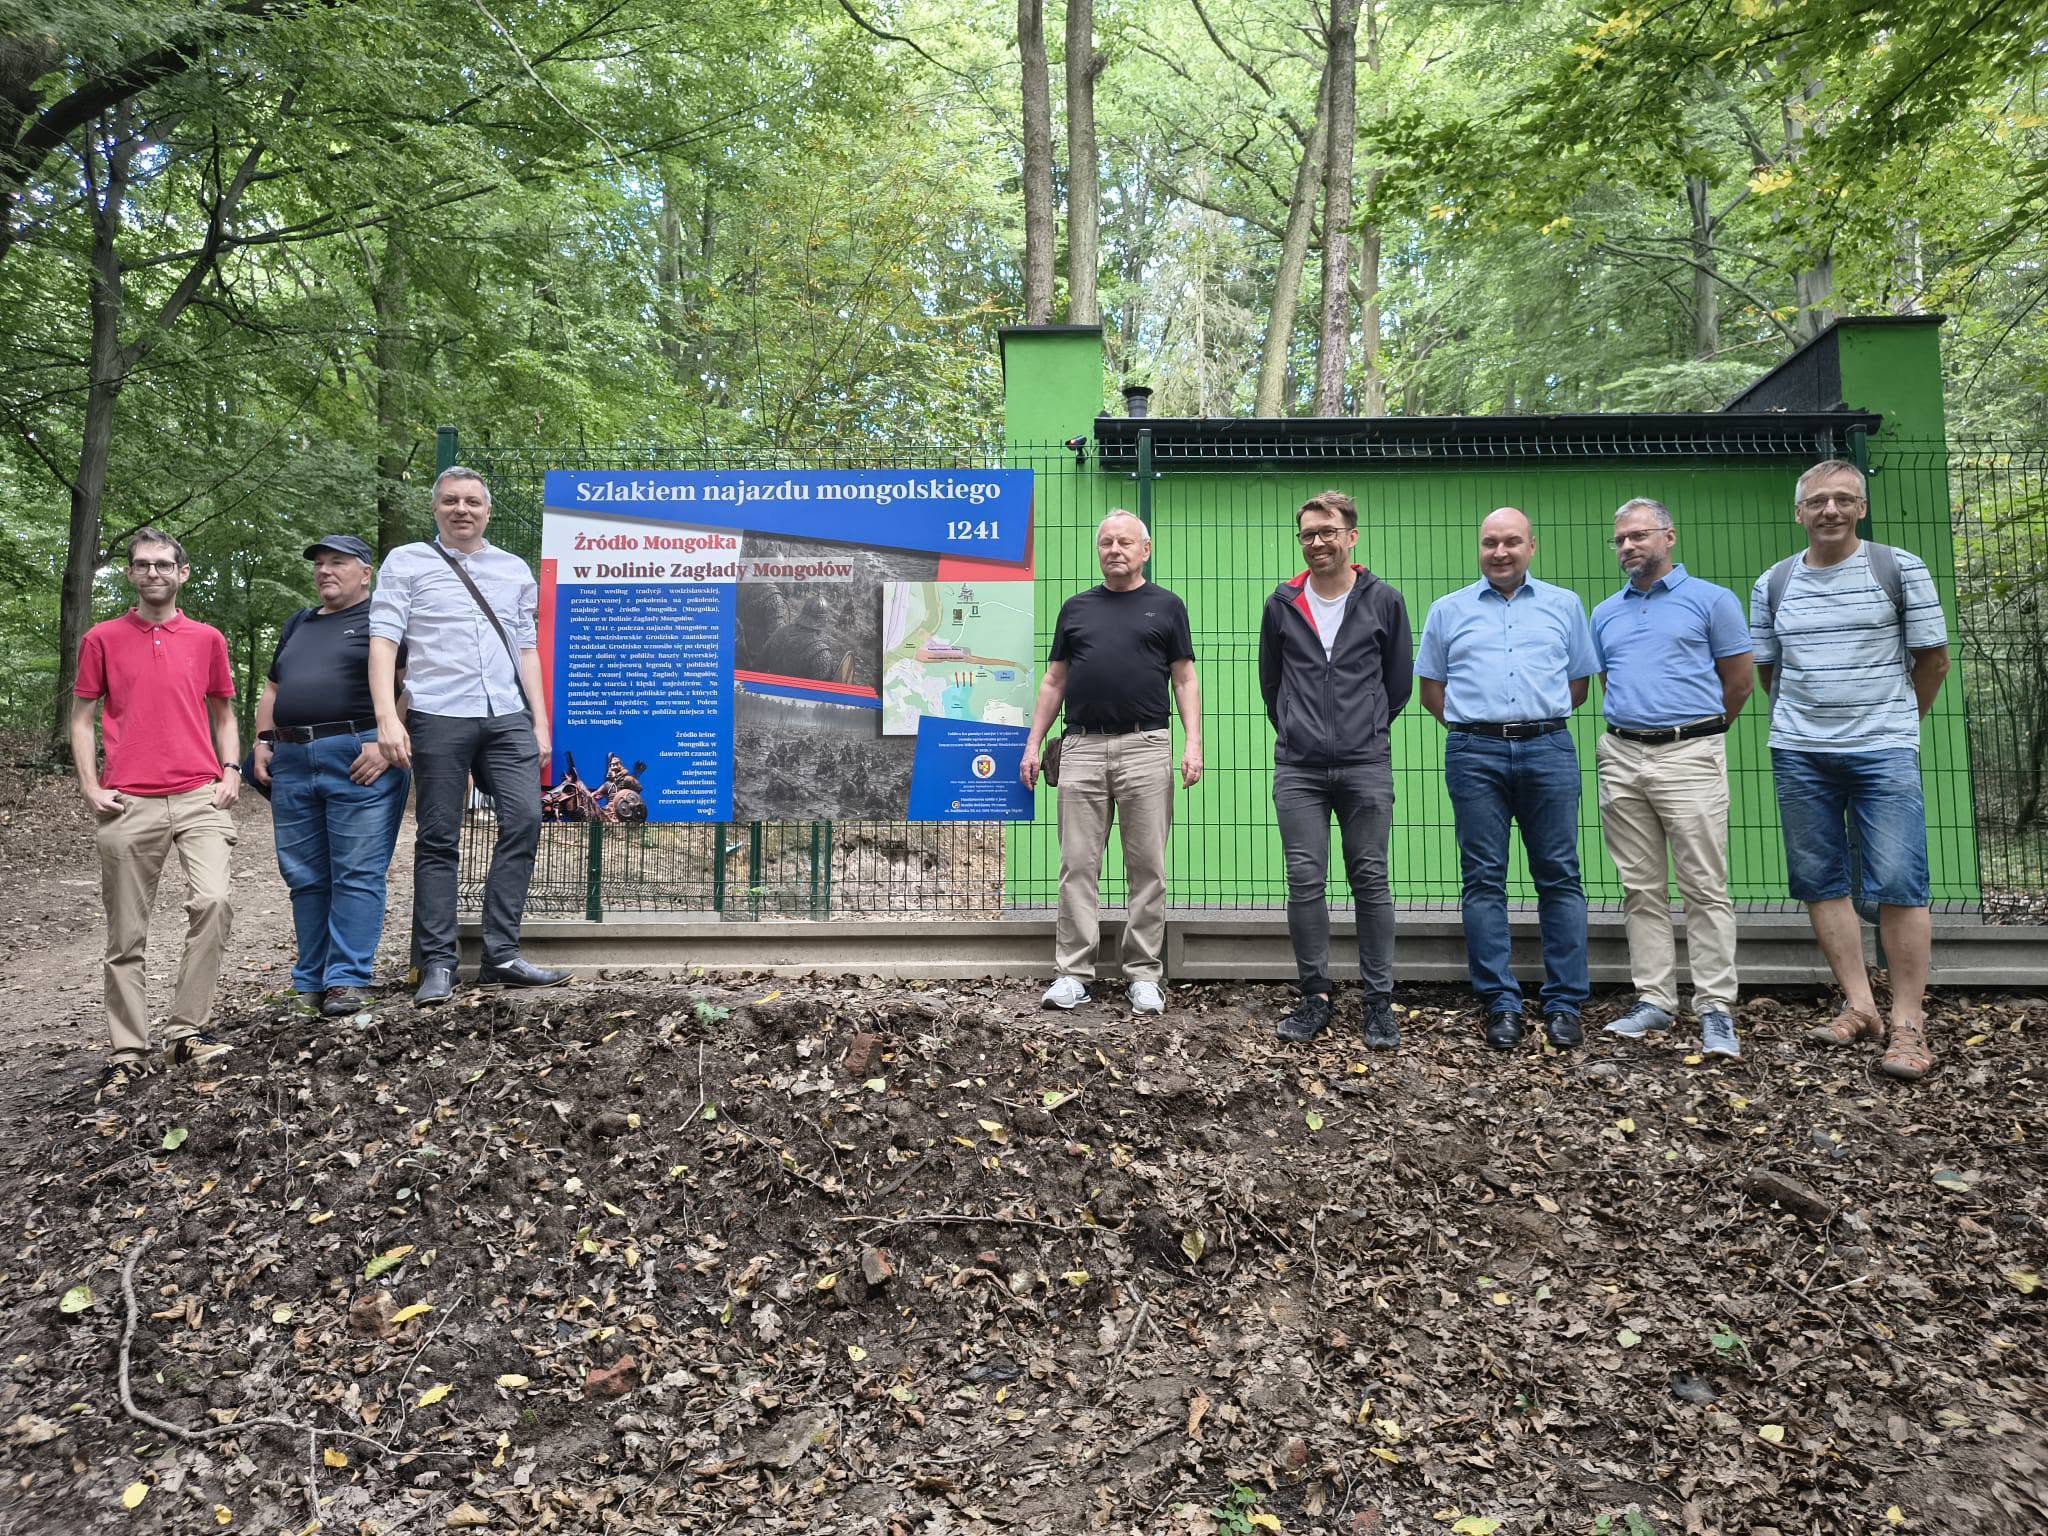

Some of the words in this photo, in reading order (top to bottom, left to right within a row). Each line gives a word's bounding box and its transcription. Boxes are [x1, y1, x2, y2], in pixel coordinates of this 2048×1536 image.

[576, 480, 696, 504] Szlakiem
[702, 480, 809, 506] najazdu
[814, 478, 1001, 506] mongolskiego
[945, 519, 1000, 541] 1241
[573, 532, 639, 551] Źródło
[643, 534, 738, 554] Mongołka
[573, 565, 591, 578] w
[596, 563, 666, 580] Dolinie
[670, 563, 747, 581] Zagłady
[752, 564, 853, 582] Mongołów
